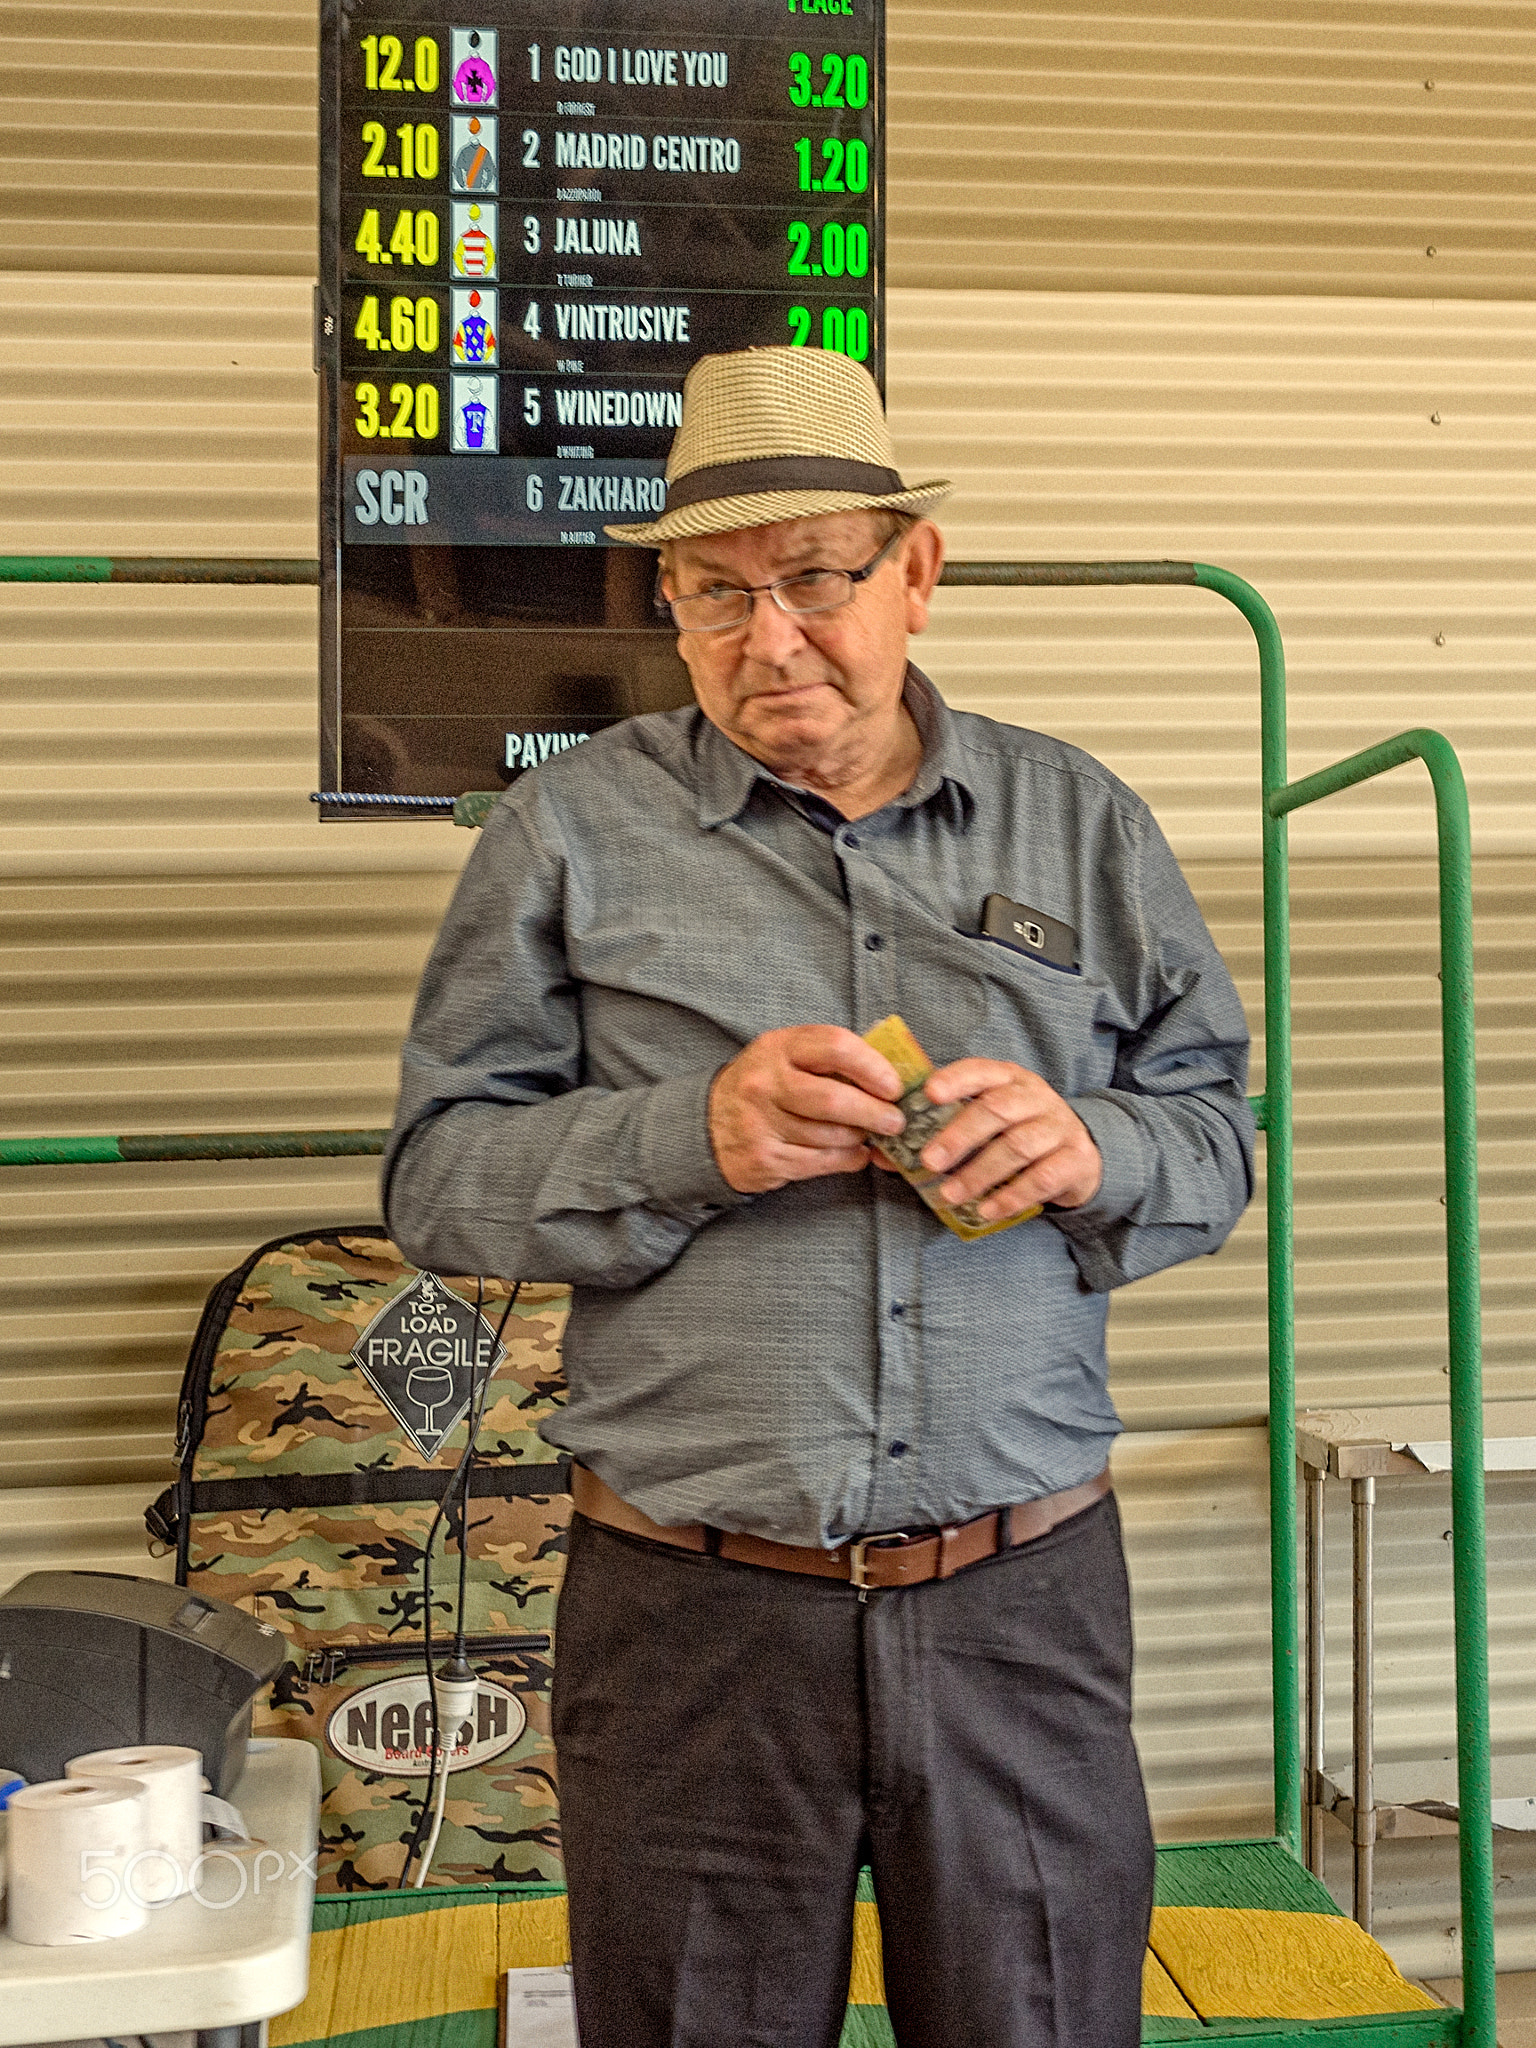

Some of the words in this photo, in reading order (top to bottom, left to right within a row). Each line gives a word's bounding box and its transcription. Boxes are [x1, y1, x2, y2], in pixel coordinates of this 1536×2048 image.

[360, 35, 439, 92] 12.0
[527, 43, 540, 83] 1
[554, 46, 601, 84] GOD
[607, 47, 617, 84] I
[622, 48, 679, 87] LOVE
[682, 50, 728, 88] YOU
[788, 52, 868, 109] 3.20
[361, 122, 439, 178] 2.10
[522, 130, 540, 169] 2
[555, 131, 646, 172] MADRID
[652, 135, 740, 174] CENTRO
[794, 138, 868, 193] 1.20
[355, 209, 440, 266] 4.40
[523, 216, 540, 254] 3
[554, 217, 642, 256] JALUNA
[787, 221, 868, 278] 2.00
[355, 296, 440, 352] 4.60
[523, 302, 541, 340] 4
[555, 304, 690, 342] VINTRUSIVE
[787, 306, 869, 361] 200
[355, 383, 440, 439] 3.20
[523, 388, 541, 426] 5
[554, 390, 683, 427] WINEDOWN
[355, 469, 429, 525] SCR
[526, 474, 543, 512] 6
[558, 475, 670, 512] ZAKHARO
[505, 732, 590, 769] PAYI
[401, 1317, 458, 1334] LOAD
[408, 1301, 448, 1315] TOP
[368, 1338, 492, 1367] FRAGILE
[425, 1745, 469, 1758] Coers
